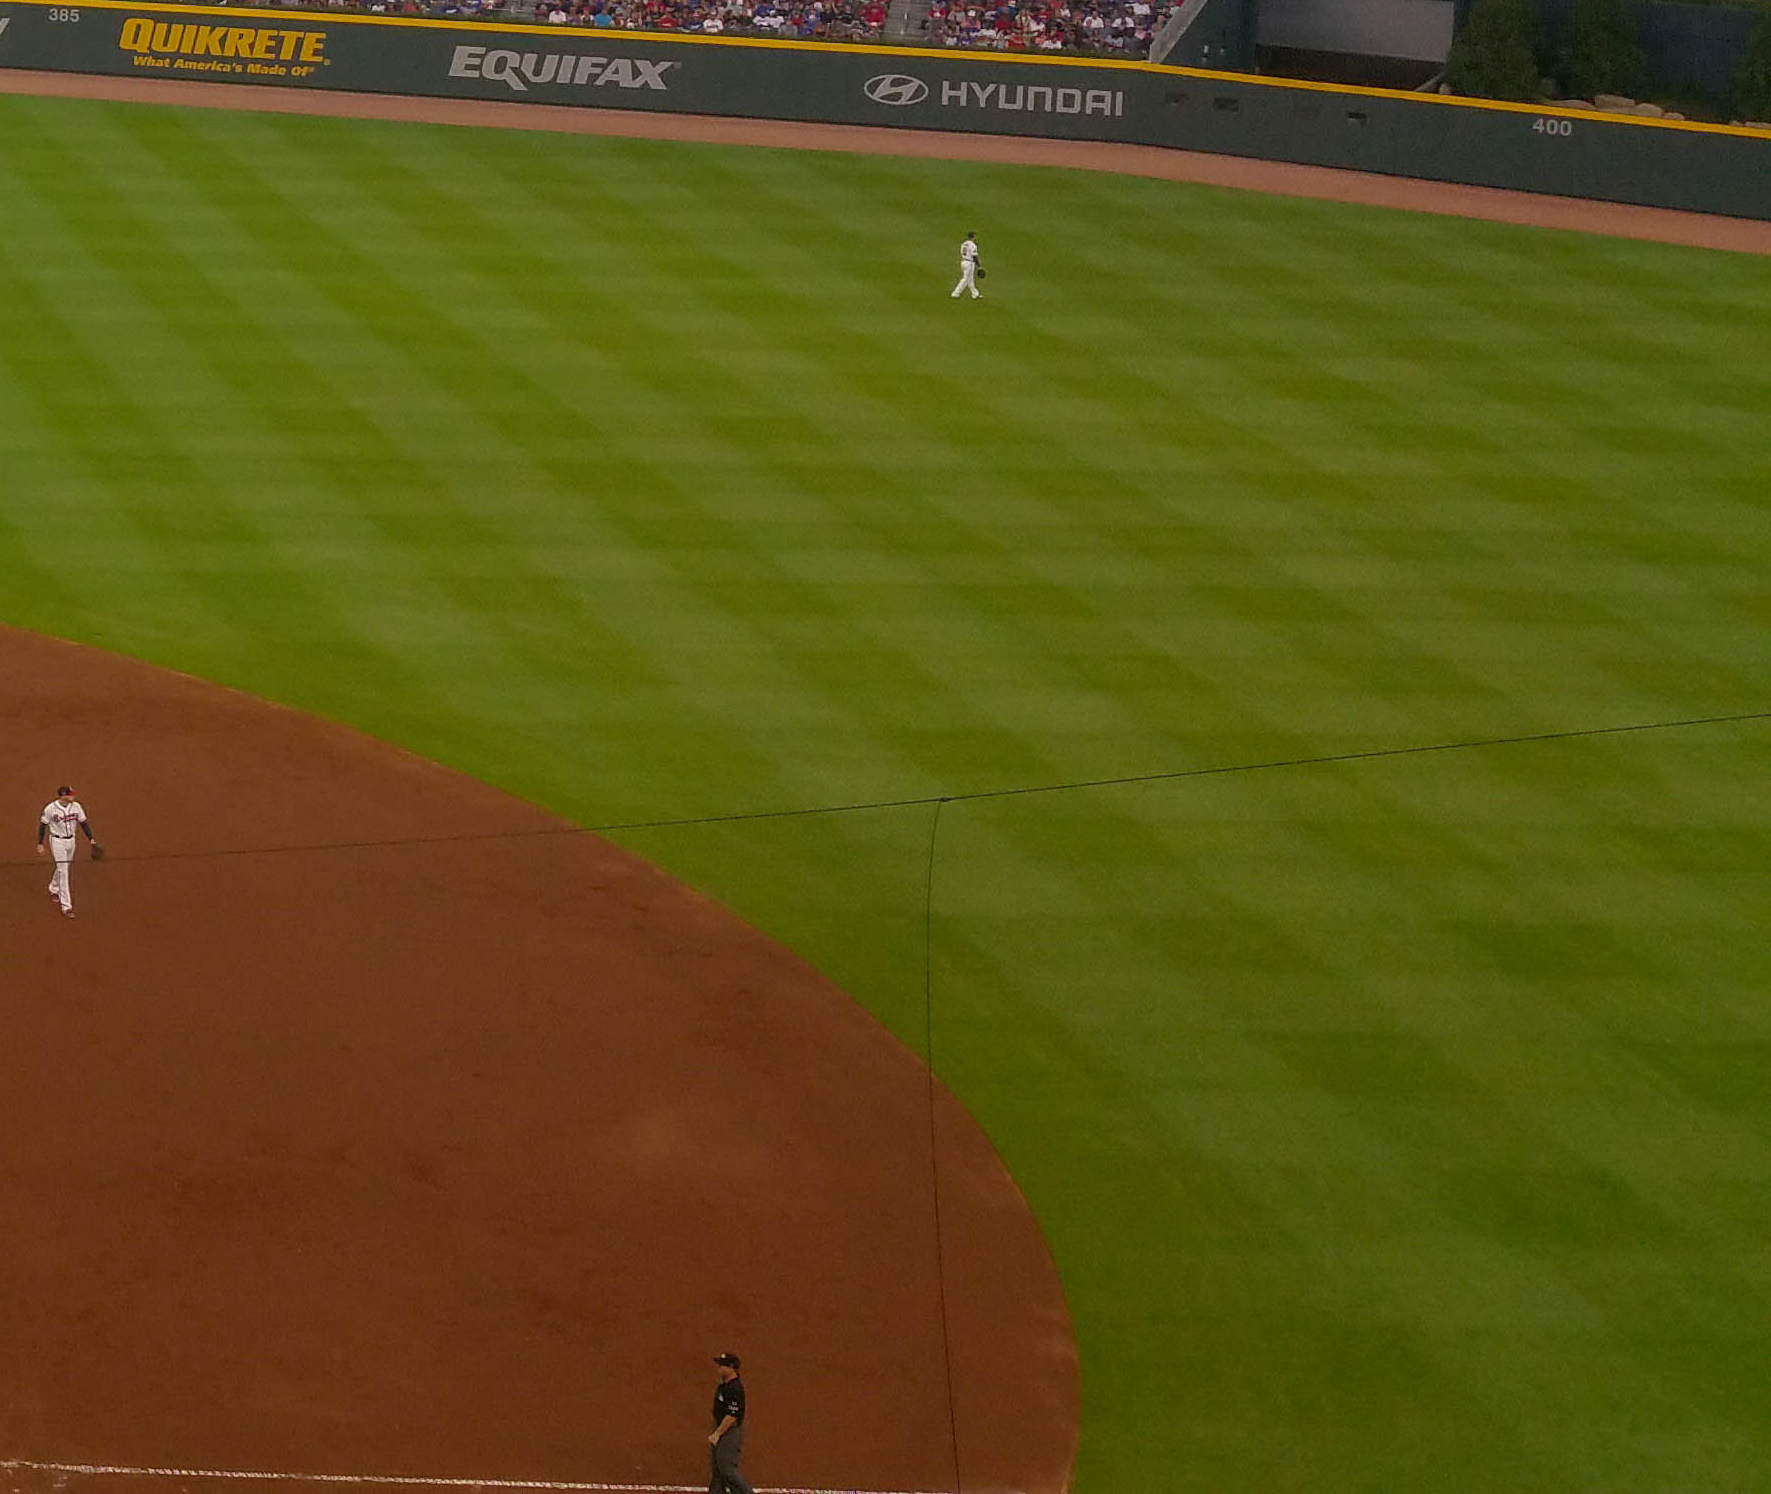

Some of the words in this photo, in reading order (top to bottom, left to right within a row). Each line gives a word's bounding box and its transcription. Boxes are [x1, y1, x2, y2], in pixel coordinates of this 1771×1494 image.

[49, 8, 80, 23] 385
[119, 17, 326, 63] QUIKRETE
[134, 56, 170, 69] What
[173, 58, 242, 74] America's
[246, 62, 286, 75] Made
[448, 46, 673, 91] EQUIFAX
[942, 81, 1123, 118] HYUNDAI
[1533, 118, 1572, 137] 400
